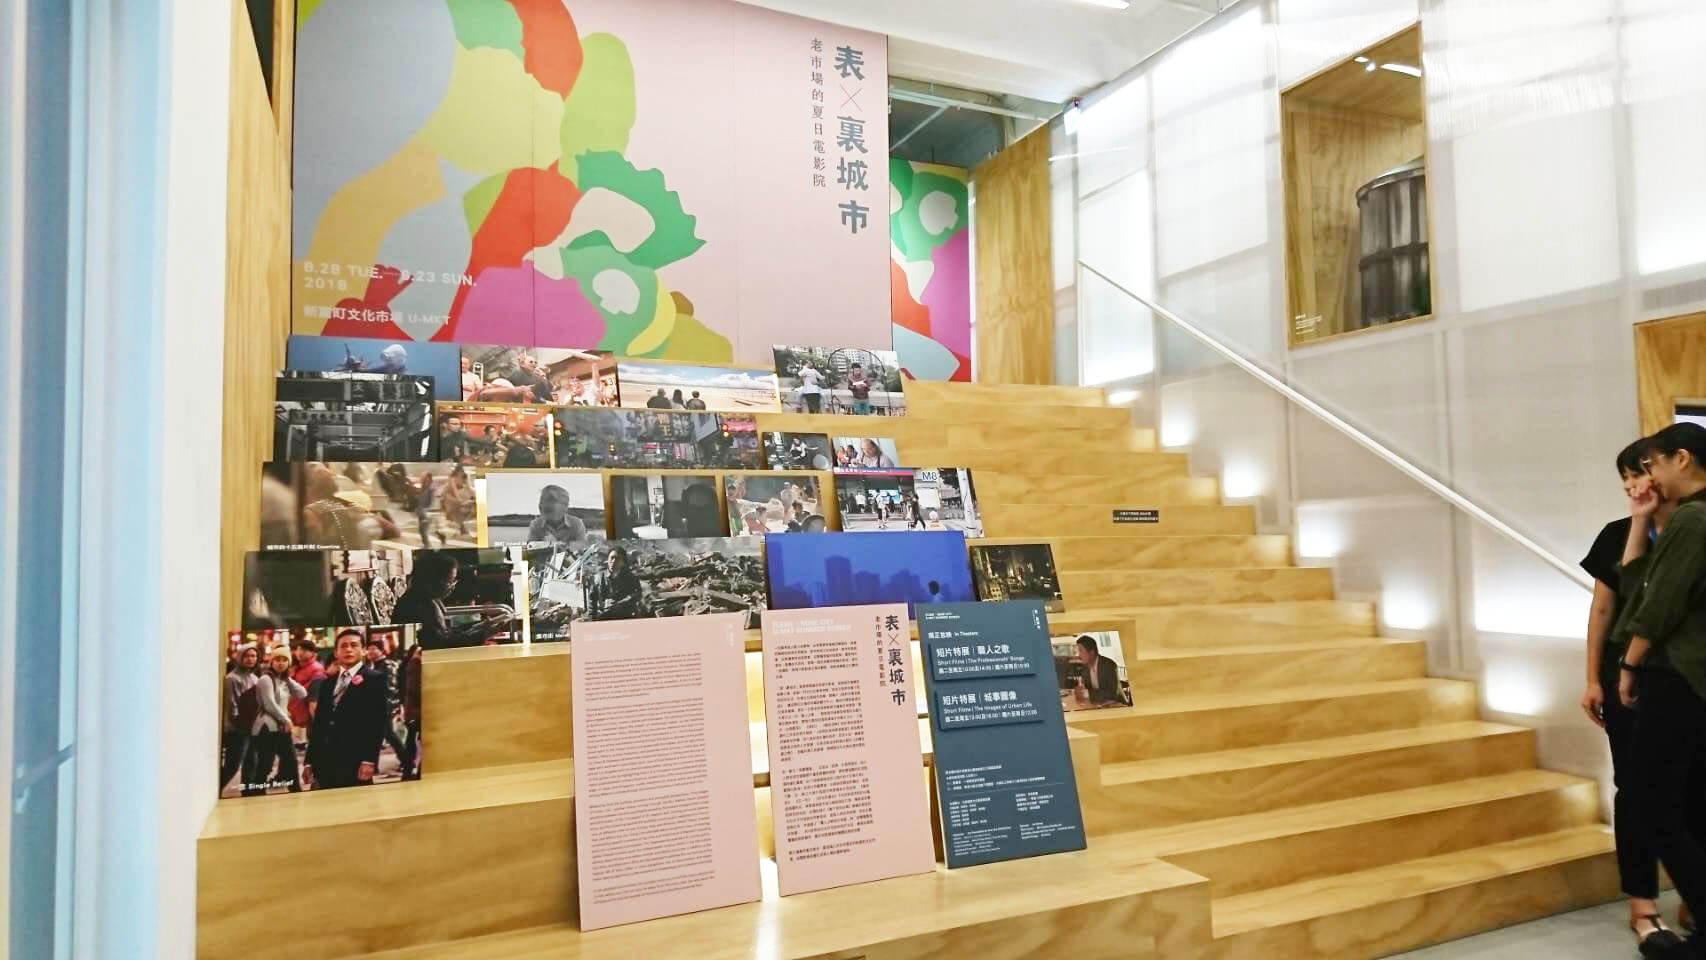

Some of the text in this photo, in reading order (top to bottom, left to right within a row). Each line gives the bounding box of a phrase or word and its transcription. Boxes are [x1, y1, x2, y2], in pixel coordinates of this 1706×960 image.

[810, 37, 826, 188] 老市場的夏日電影院
